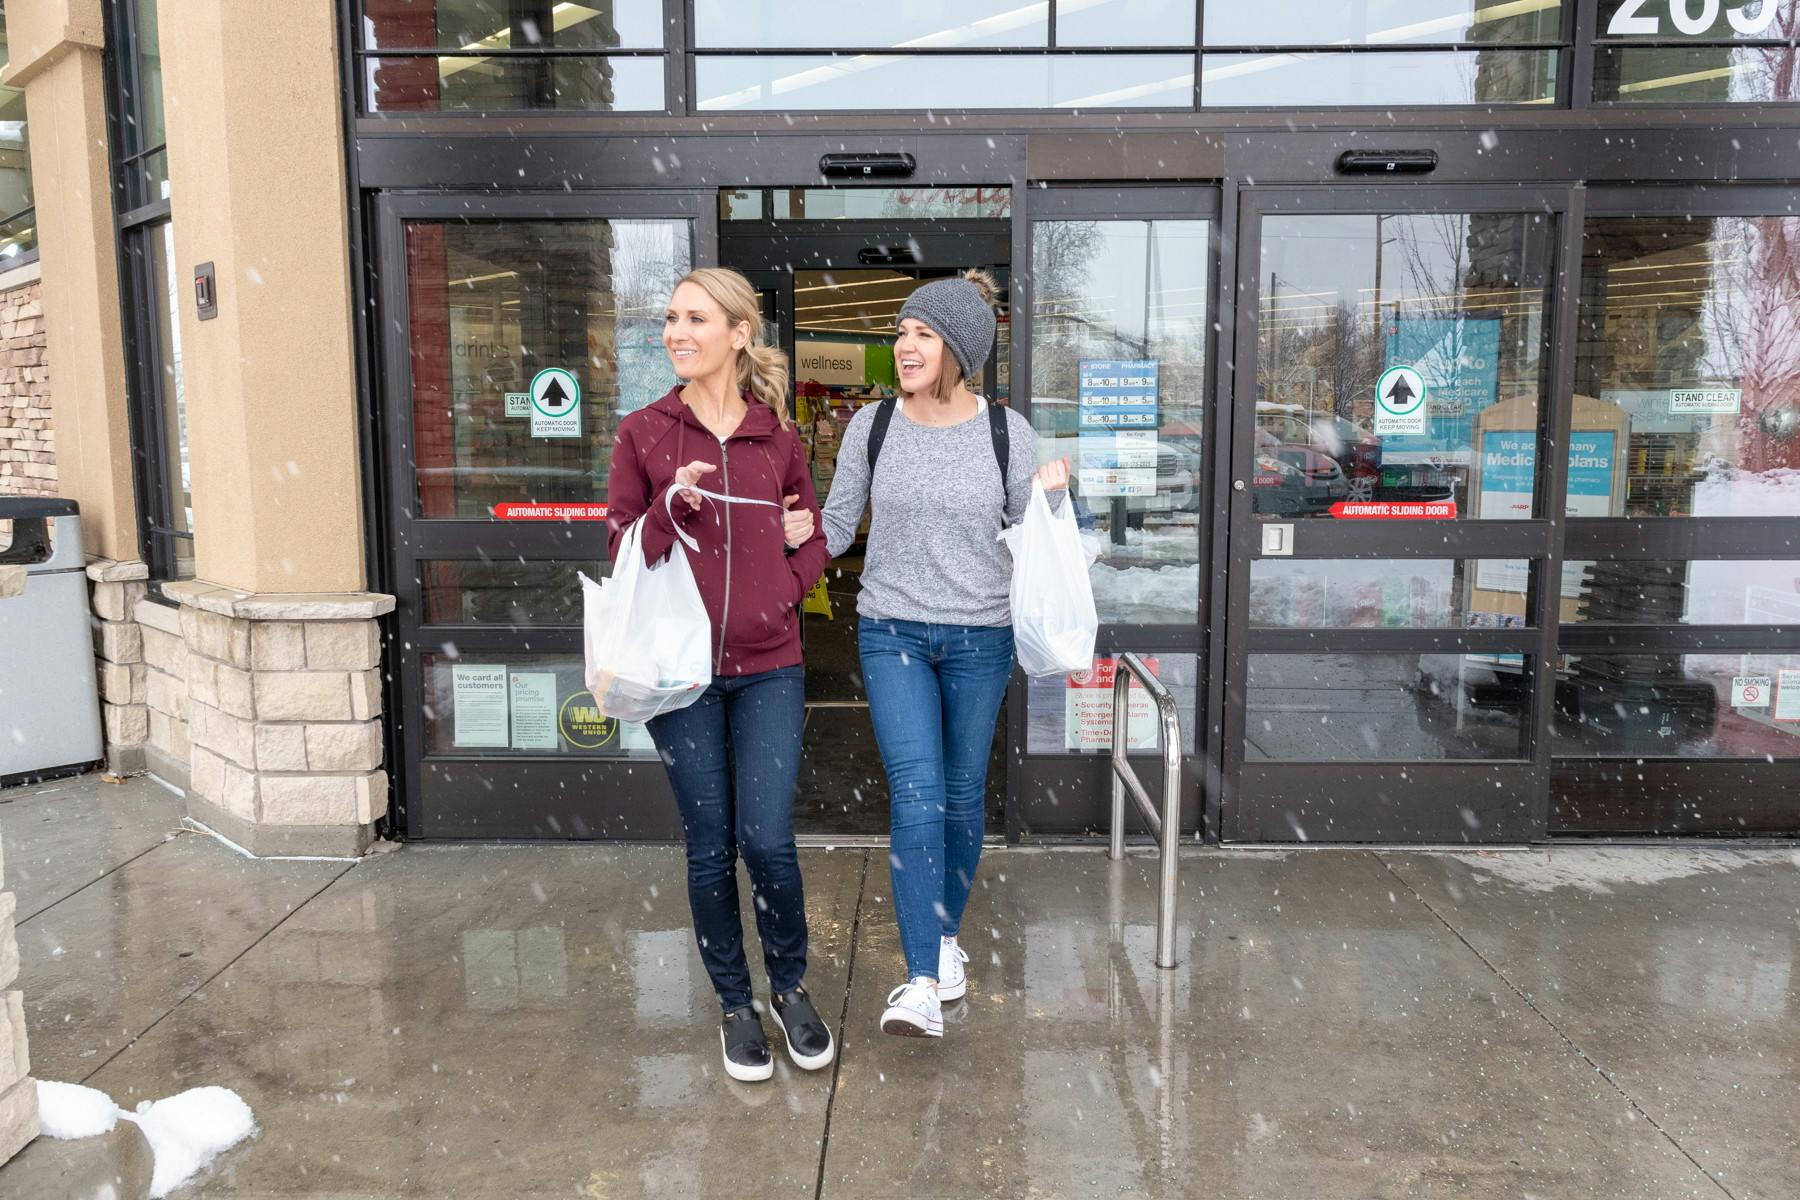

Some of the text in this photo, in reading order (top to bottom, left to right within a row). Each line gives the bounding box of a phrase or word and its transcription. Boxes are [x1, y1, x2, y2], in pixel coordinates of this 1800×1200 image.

[801, 355, 853, 370] wellness
[509, 396, 531, 406] STAN
[1674, 392, 1735, 401] STAND CLEAR
[1500, 440, 1517, 450] We
[1486, 452, 1536, 466] Medic
[507, 507, 552, 517] AUTOMATIC
[554, 507, 586, 517] SLIDING
[1343, 505, 1448, 515] AUTOMATIC SLIDING DOOR
[1096, 663, 1113, 672] For
[1744, 678, 1770, 686] SMOKING
[1081, 701, 1113, 709] Security
